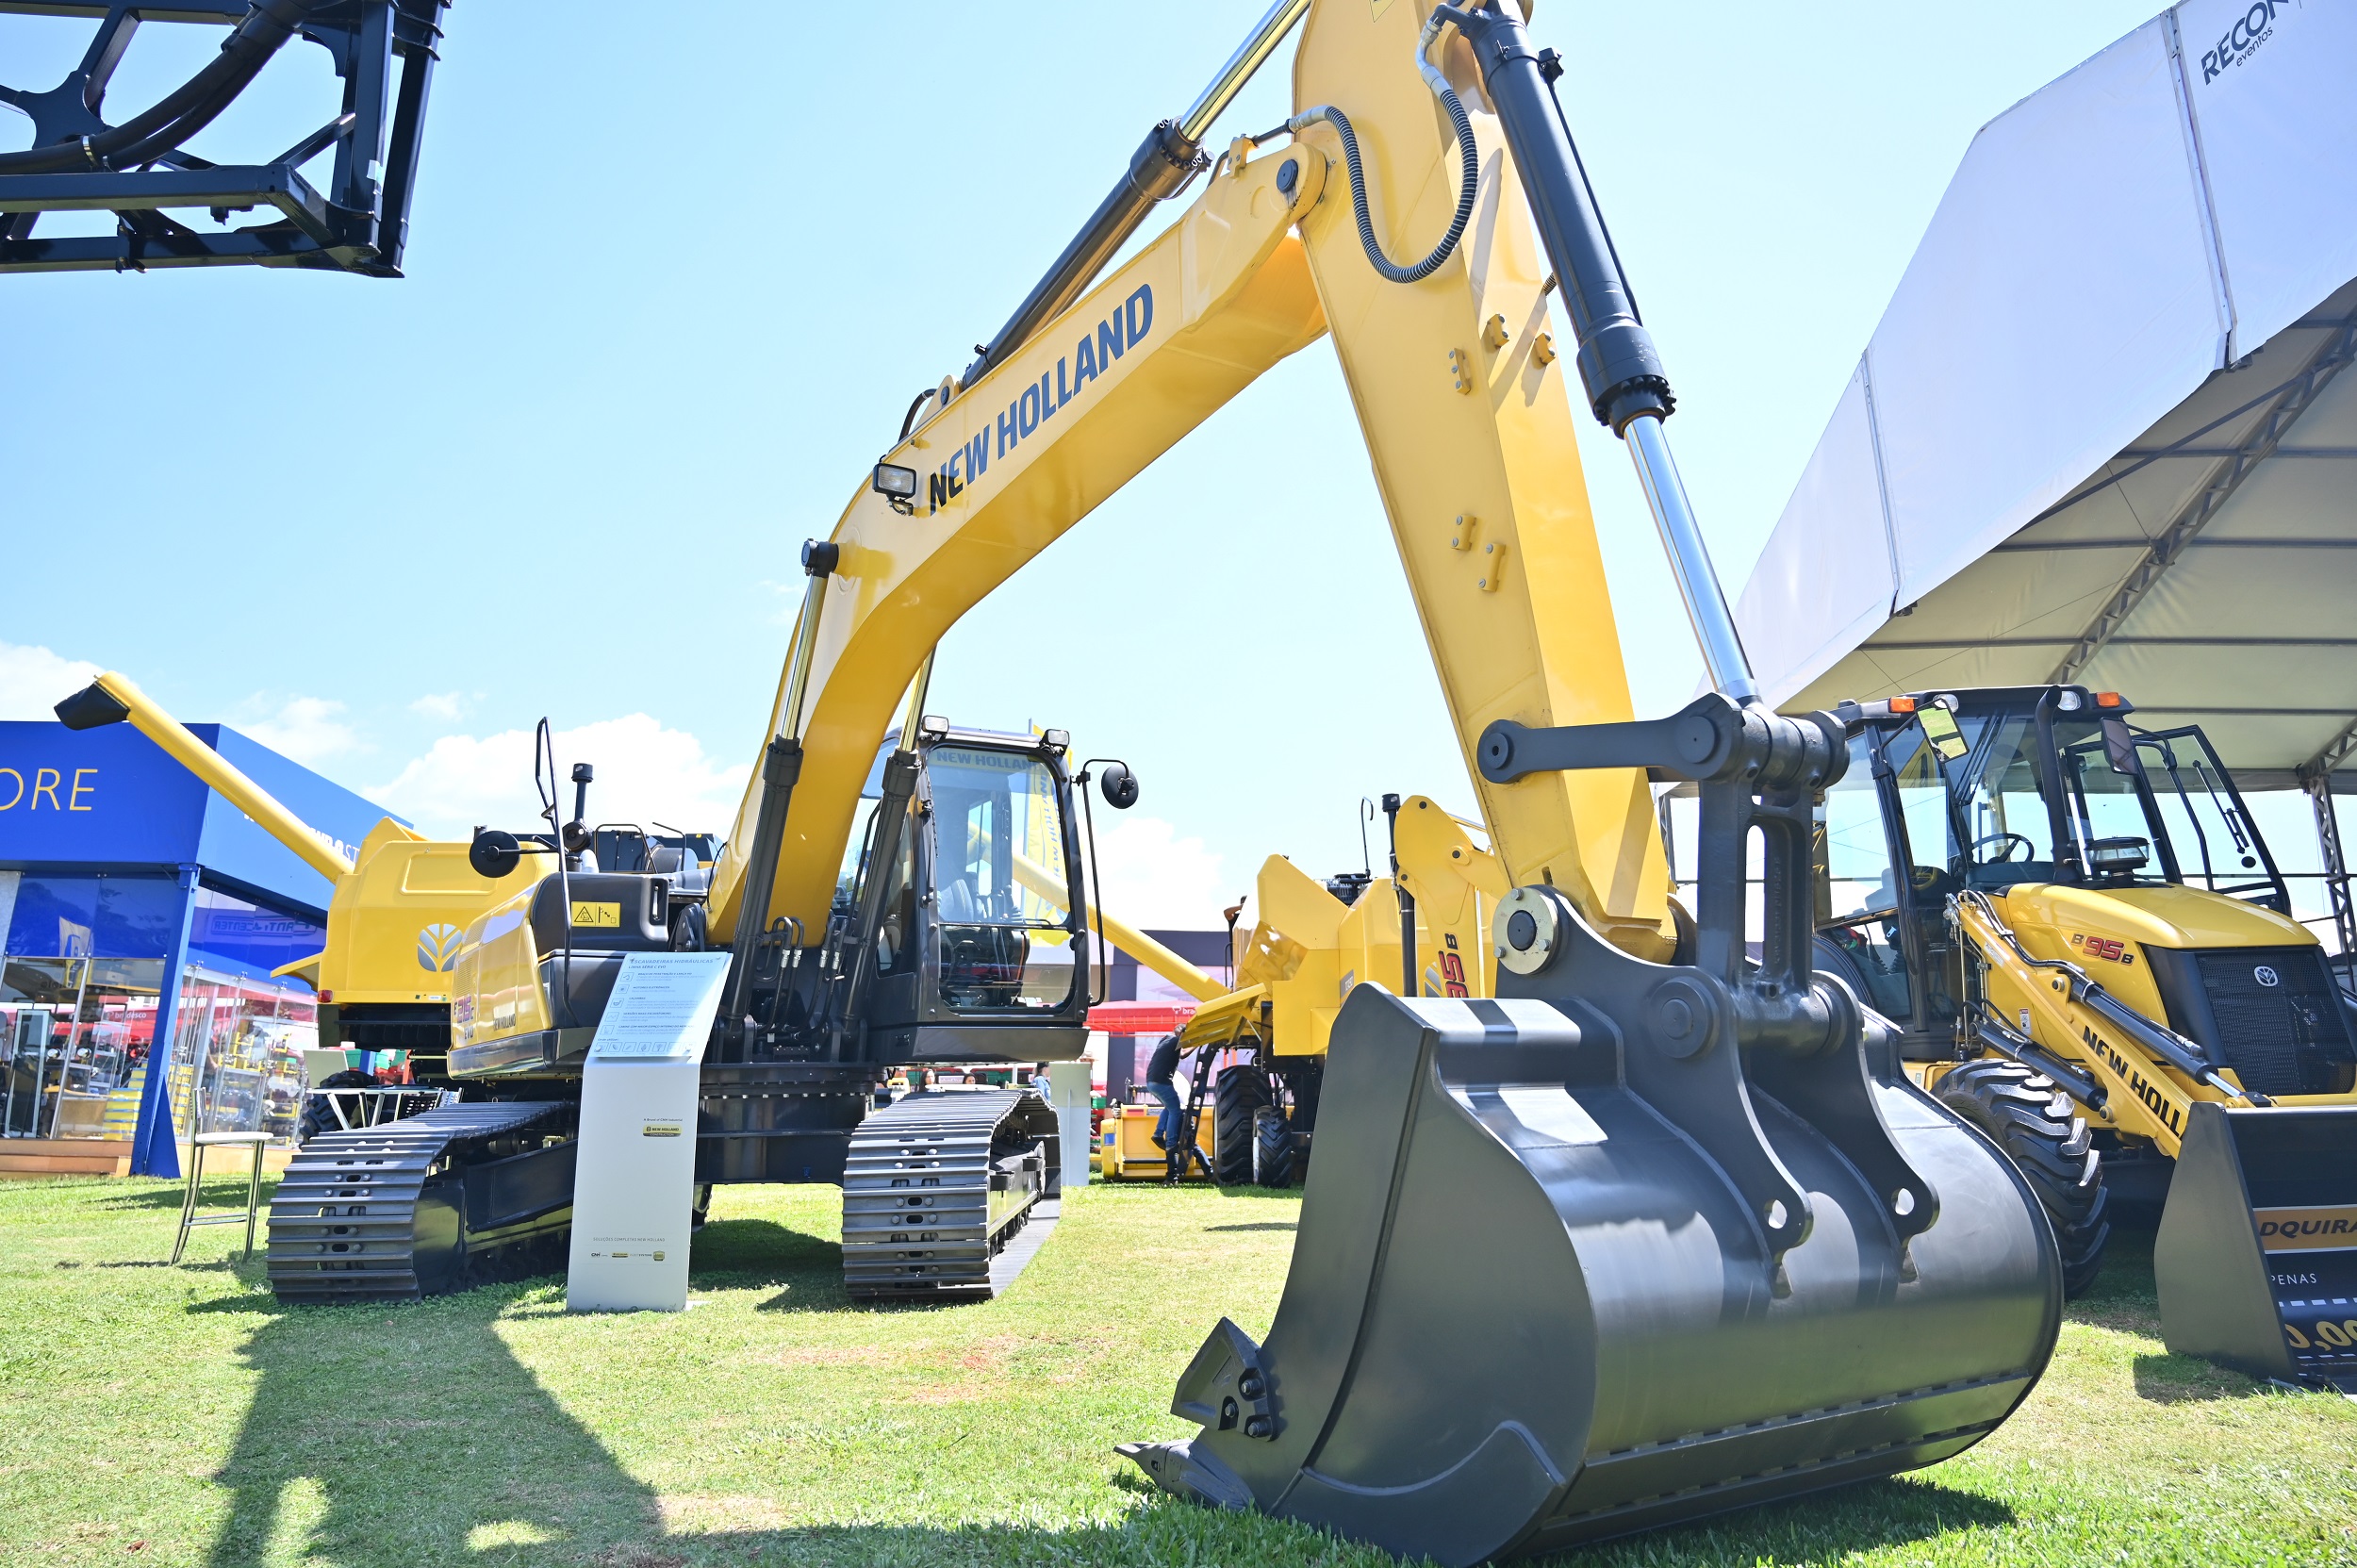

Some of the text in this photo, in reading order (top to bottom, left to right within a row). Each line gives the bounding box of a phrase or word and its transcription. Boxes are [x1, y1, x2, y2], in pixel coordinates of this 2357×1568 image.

[2236, 26, 2273, 67] eventos
[931, 284, 1153, 517] NEW HOLLAND
[936, 751, 971, 765] NEW
[2083, 1025, 2184, 1141] NEW HOLL
